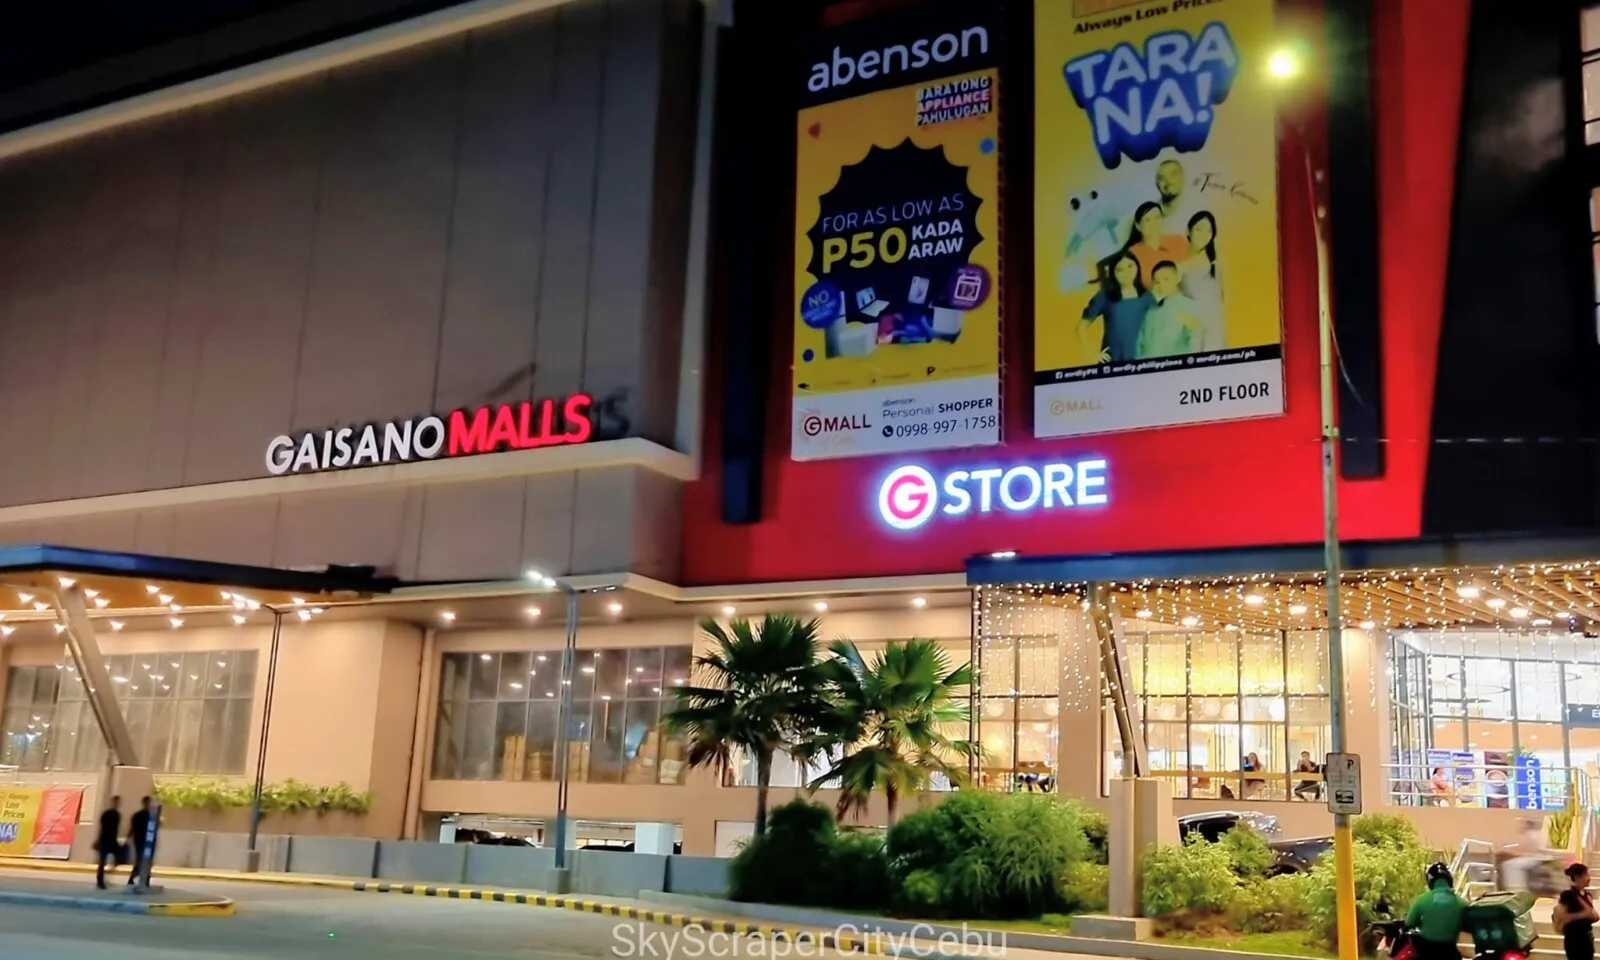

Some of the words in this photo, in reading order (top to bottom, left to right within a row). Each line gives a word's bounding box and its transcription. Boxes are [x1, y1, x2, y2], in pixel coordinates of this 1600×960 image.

[1073, 14, 1132, 34] Always
[1136, 5, 1168, 20] Low
[808, 26, 988, 92] abenson
[1066, 23, 1236, 99] TARA
[915, 103, 989, 127] PAHULUGAN
[917, 89, 989, 113] APPLIANCE
[1094, 72, 1212, 145] NA!
[822, 212, 858, 234] FOR
[863, 207, 887, 226] AS
[892, 199, 933, 222] LOW
[938, 193, 964, 212] AS
[822, 227, 907, 274] P50
[912, 218, 963, 240] KADA
[908, 237, 963, 260] ARAW
[808, 290, 829, 306] NO
[1179, 387, 1213, 405] 2ND
[1218, 382, 1270, 402] FLOOR
[882, 405, 935, 419] Personal
[938, 398, 993, 413] SHOPPER
[265, 415, 446, 476] GAISANO
[448, 392, 592, 457] MALLS
[896, 415, 996, 438] 0998-997-1758
[943, 459, 1108, 514] STORE
